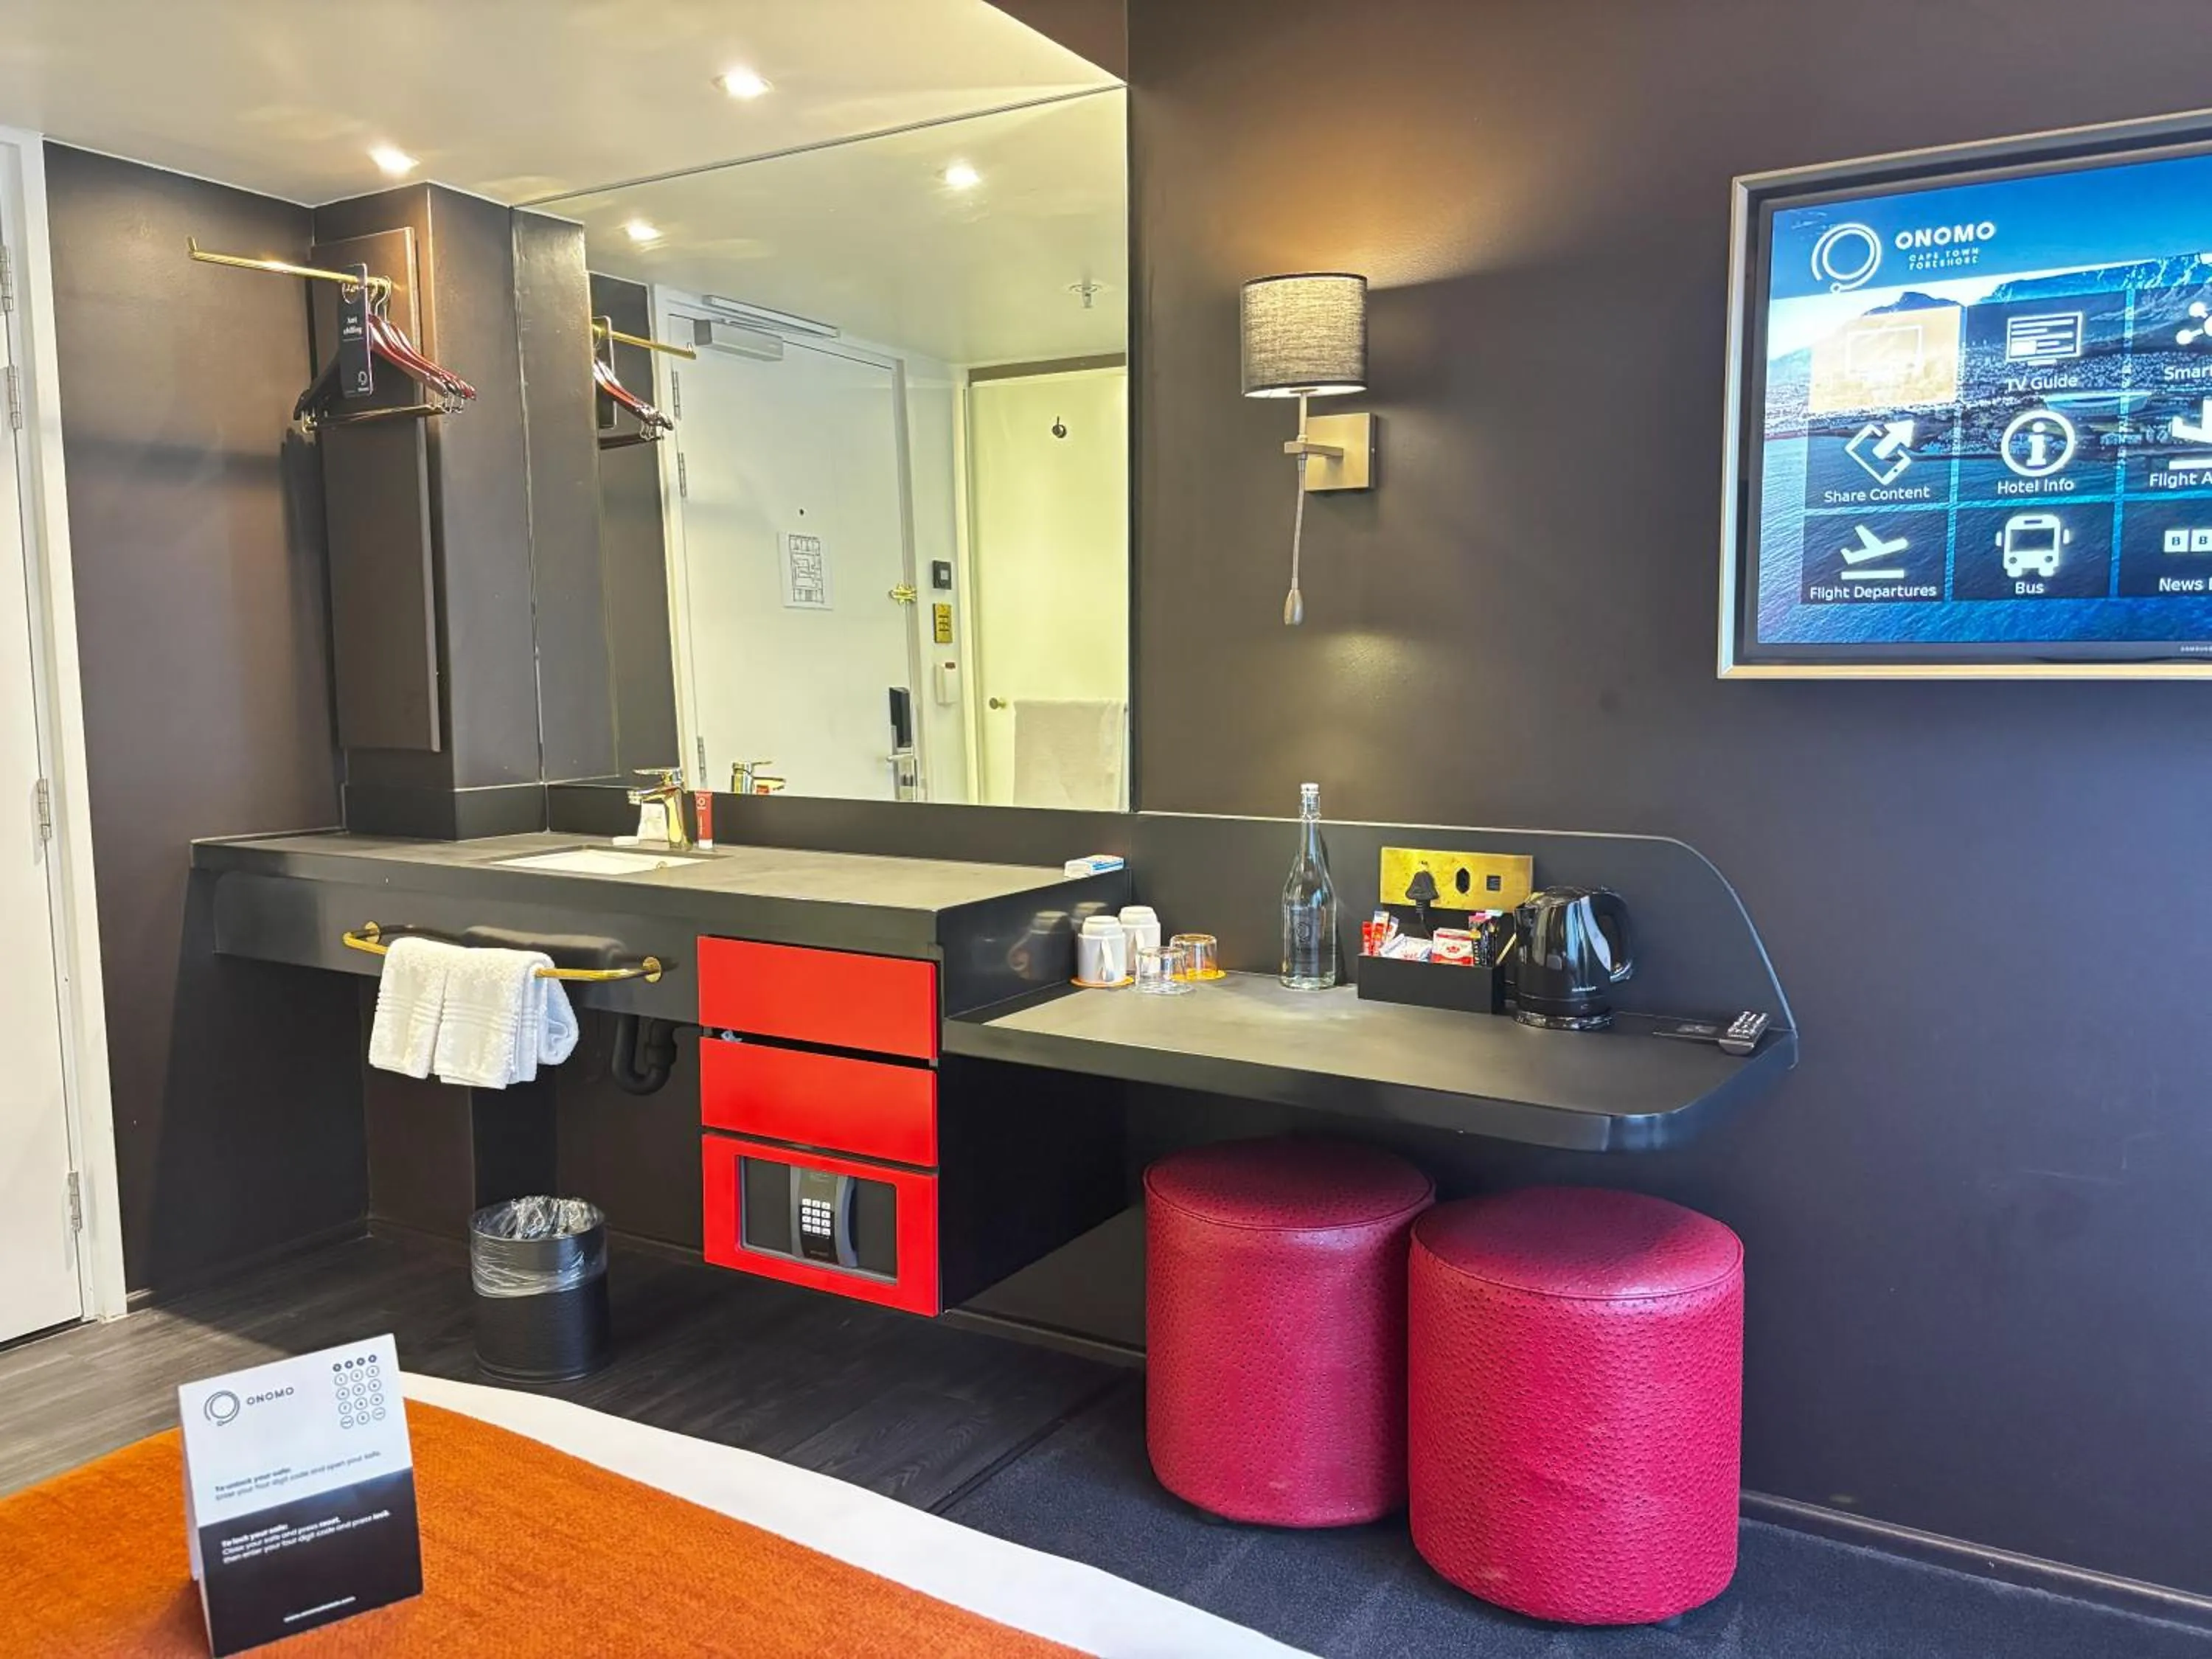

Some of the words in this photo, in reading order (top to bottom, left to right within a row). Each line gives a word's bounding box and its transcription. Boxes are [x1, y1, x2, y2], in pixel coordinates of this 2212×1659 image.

[1895, 222, 1995, 250] ONOMO
[1946, 248, 1979, 258] TOWN
[2006, 376, 2027, 392] TV
[2031, 375, 2078, 390] Guide
[1997, 479, 2038, 494] Hotel
[2044, 478, 2075, 492] Info
[2149, 472, 2198, 489] Flight
[1824, 490, 1866, 503] Share
[1869, 485, 1930, 501] Content
[2015, 582, 2045, 594] Bus
[2159, 577, 2203, 591] News
[1810, 585, 1849, 601] Flight
[1854, 585, 1937, 600] Departures
[246, 1387, 294, 1405] ONOMO
